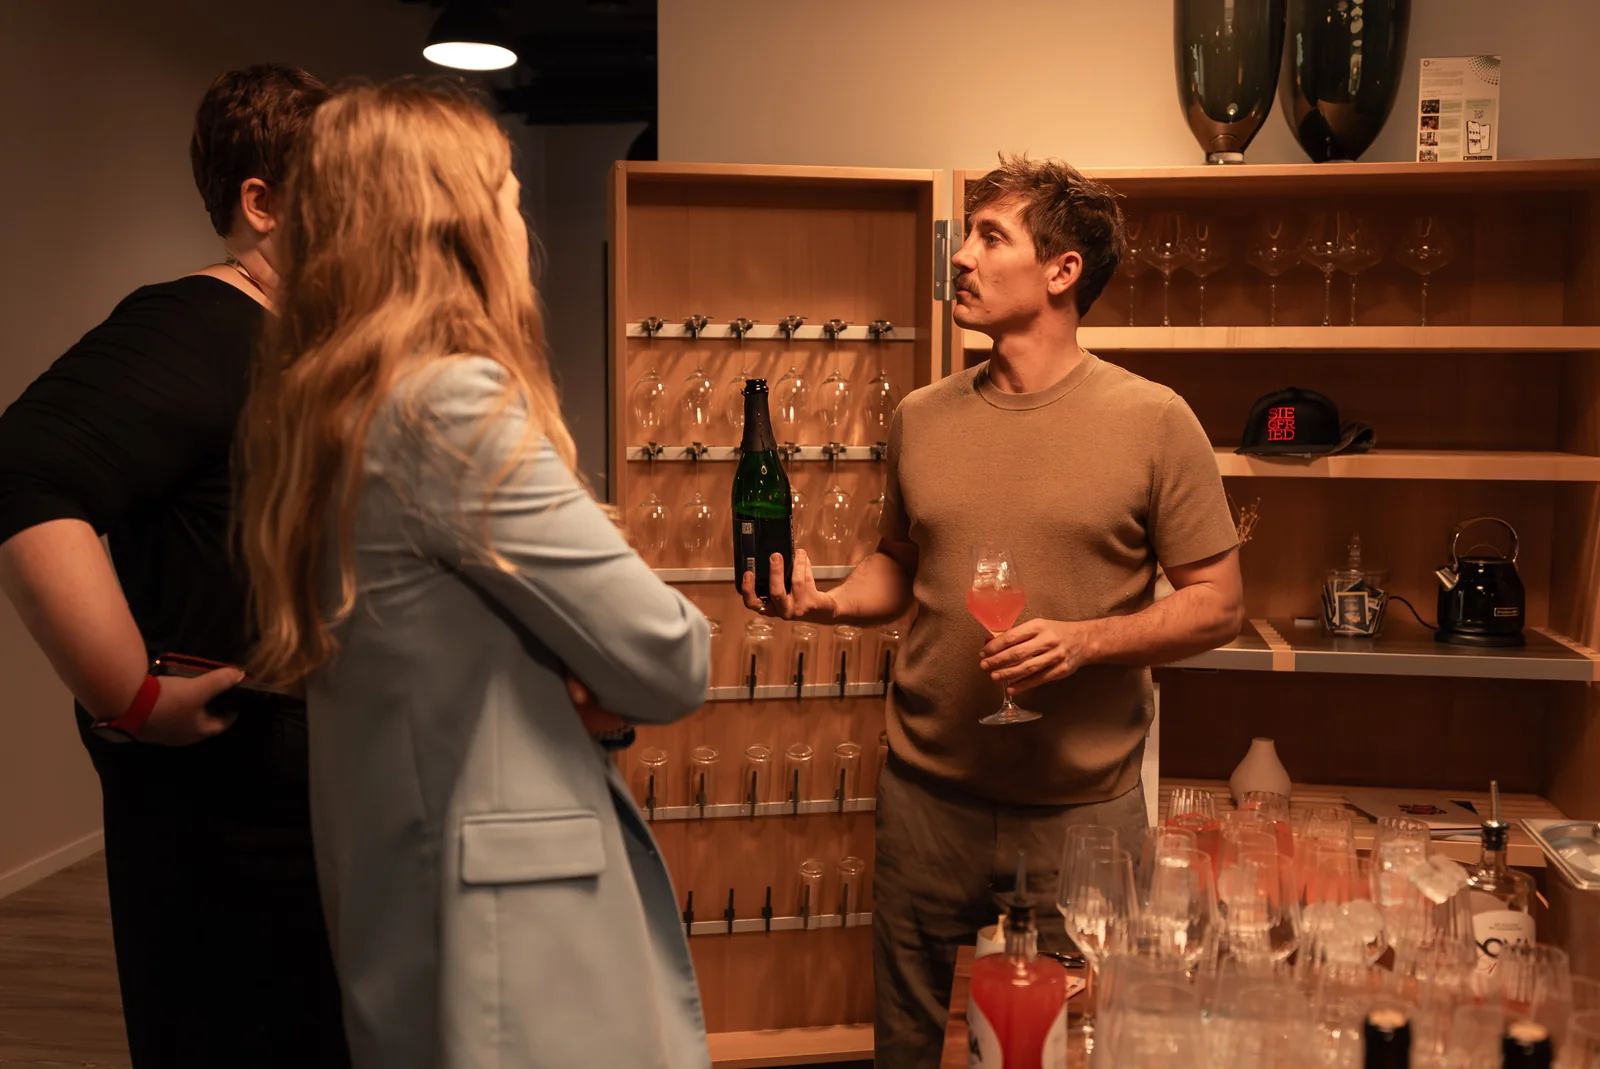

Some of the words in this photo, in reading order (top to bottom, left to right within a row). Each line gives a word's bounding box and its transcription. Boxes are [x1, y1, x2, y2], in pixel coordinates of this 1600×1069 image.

[1268, 407, 1295, 419] SIE
[1268, 420, 1296, 429] GFR
[1268, 429, 1295, 441] IED
